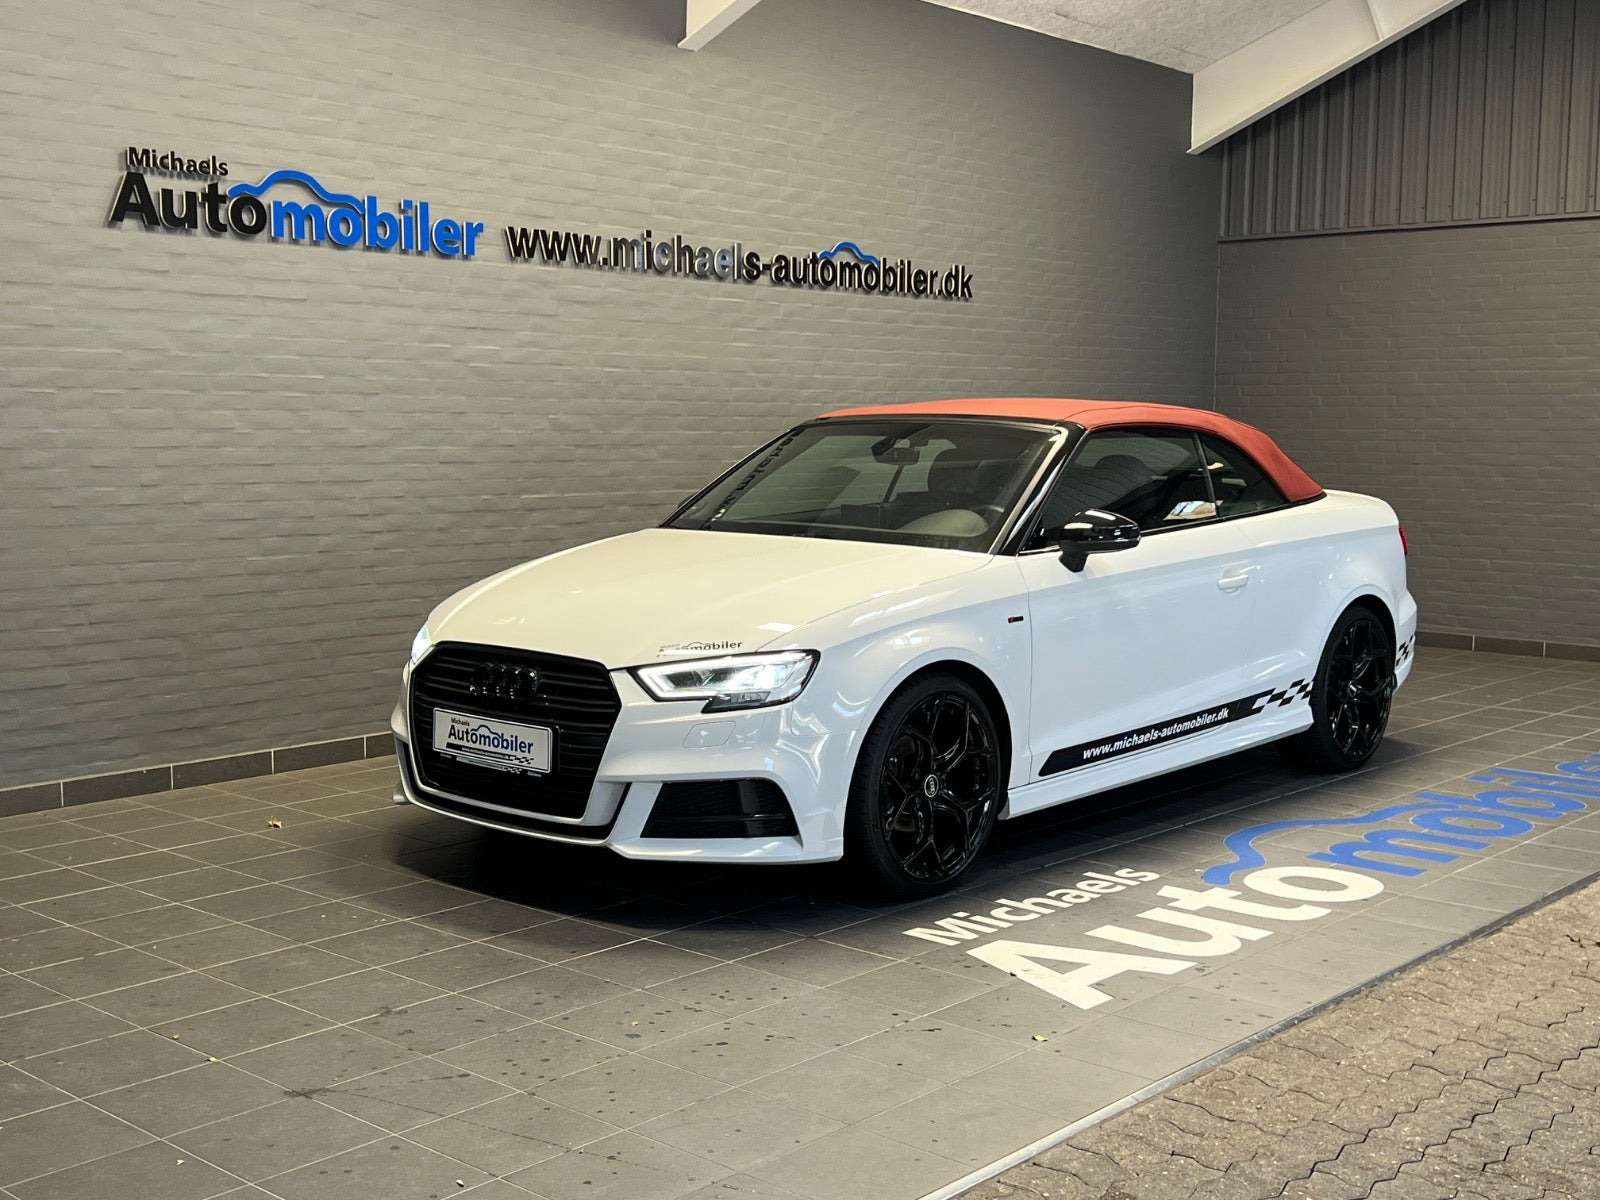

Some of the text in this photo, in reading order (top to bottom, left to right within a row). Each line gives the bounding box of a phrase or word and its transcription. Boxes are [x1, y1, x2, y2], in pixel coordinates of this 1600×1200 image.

[126, 146, 229, 177] Michaels
[108, 171, 484, 257] Automobiler
[504, 226, 974, 299] www.michaels-automobiler.dk
[448, 724, 534, 754] Automobiler
[1082, 707, 1230, 760] www.michaels-automobiler.dk
[902, 867, 1160, 946] Michaels
[965, 752, 1600, 1010] Automobil
